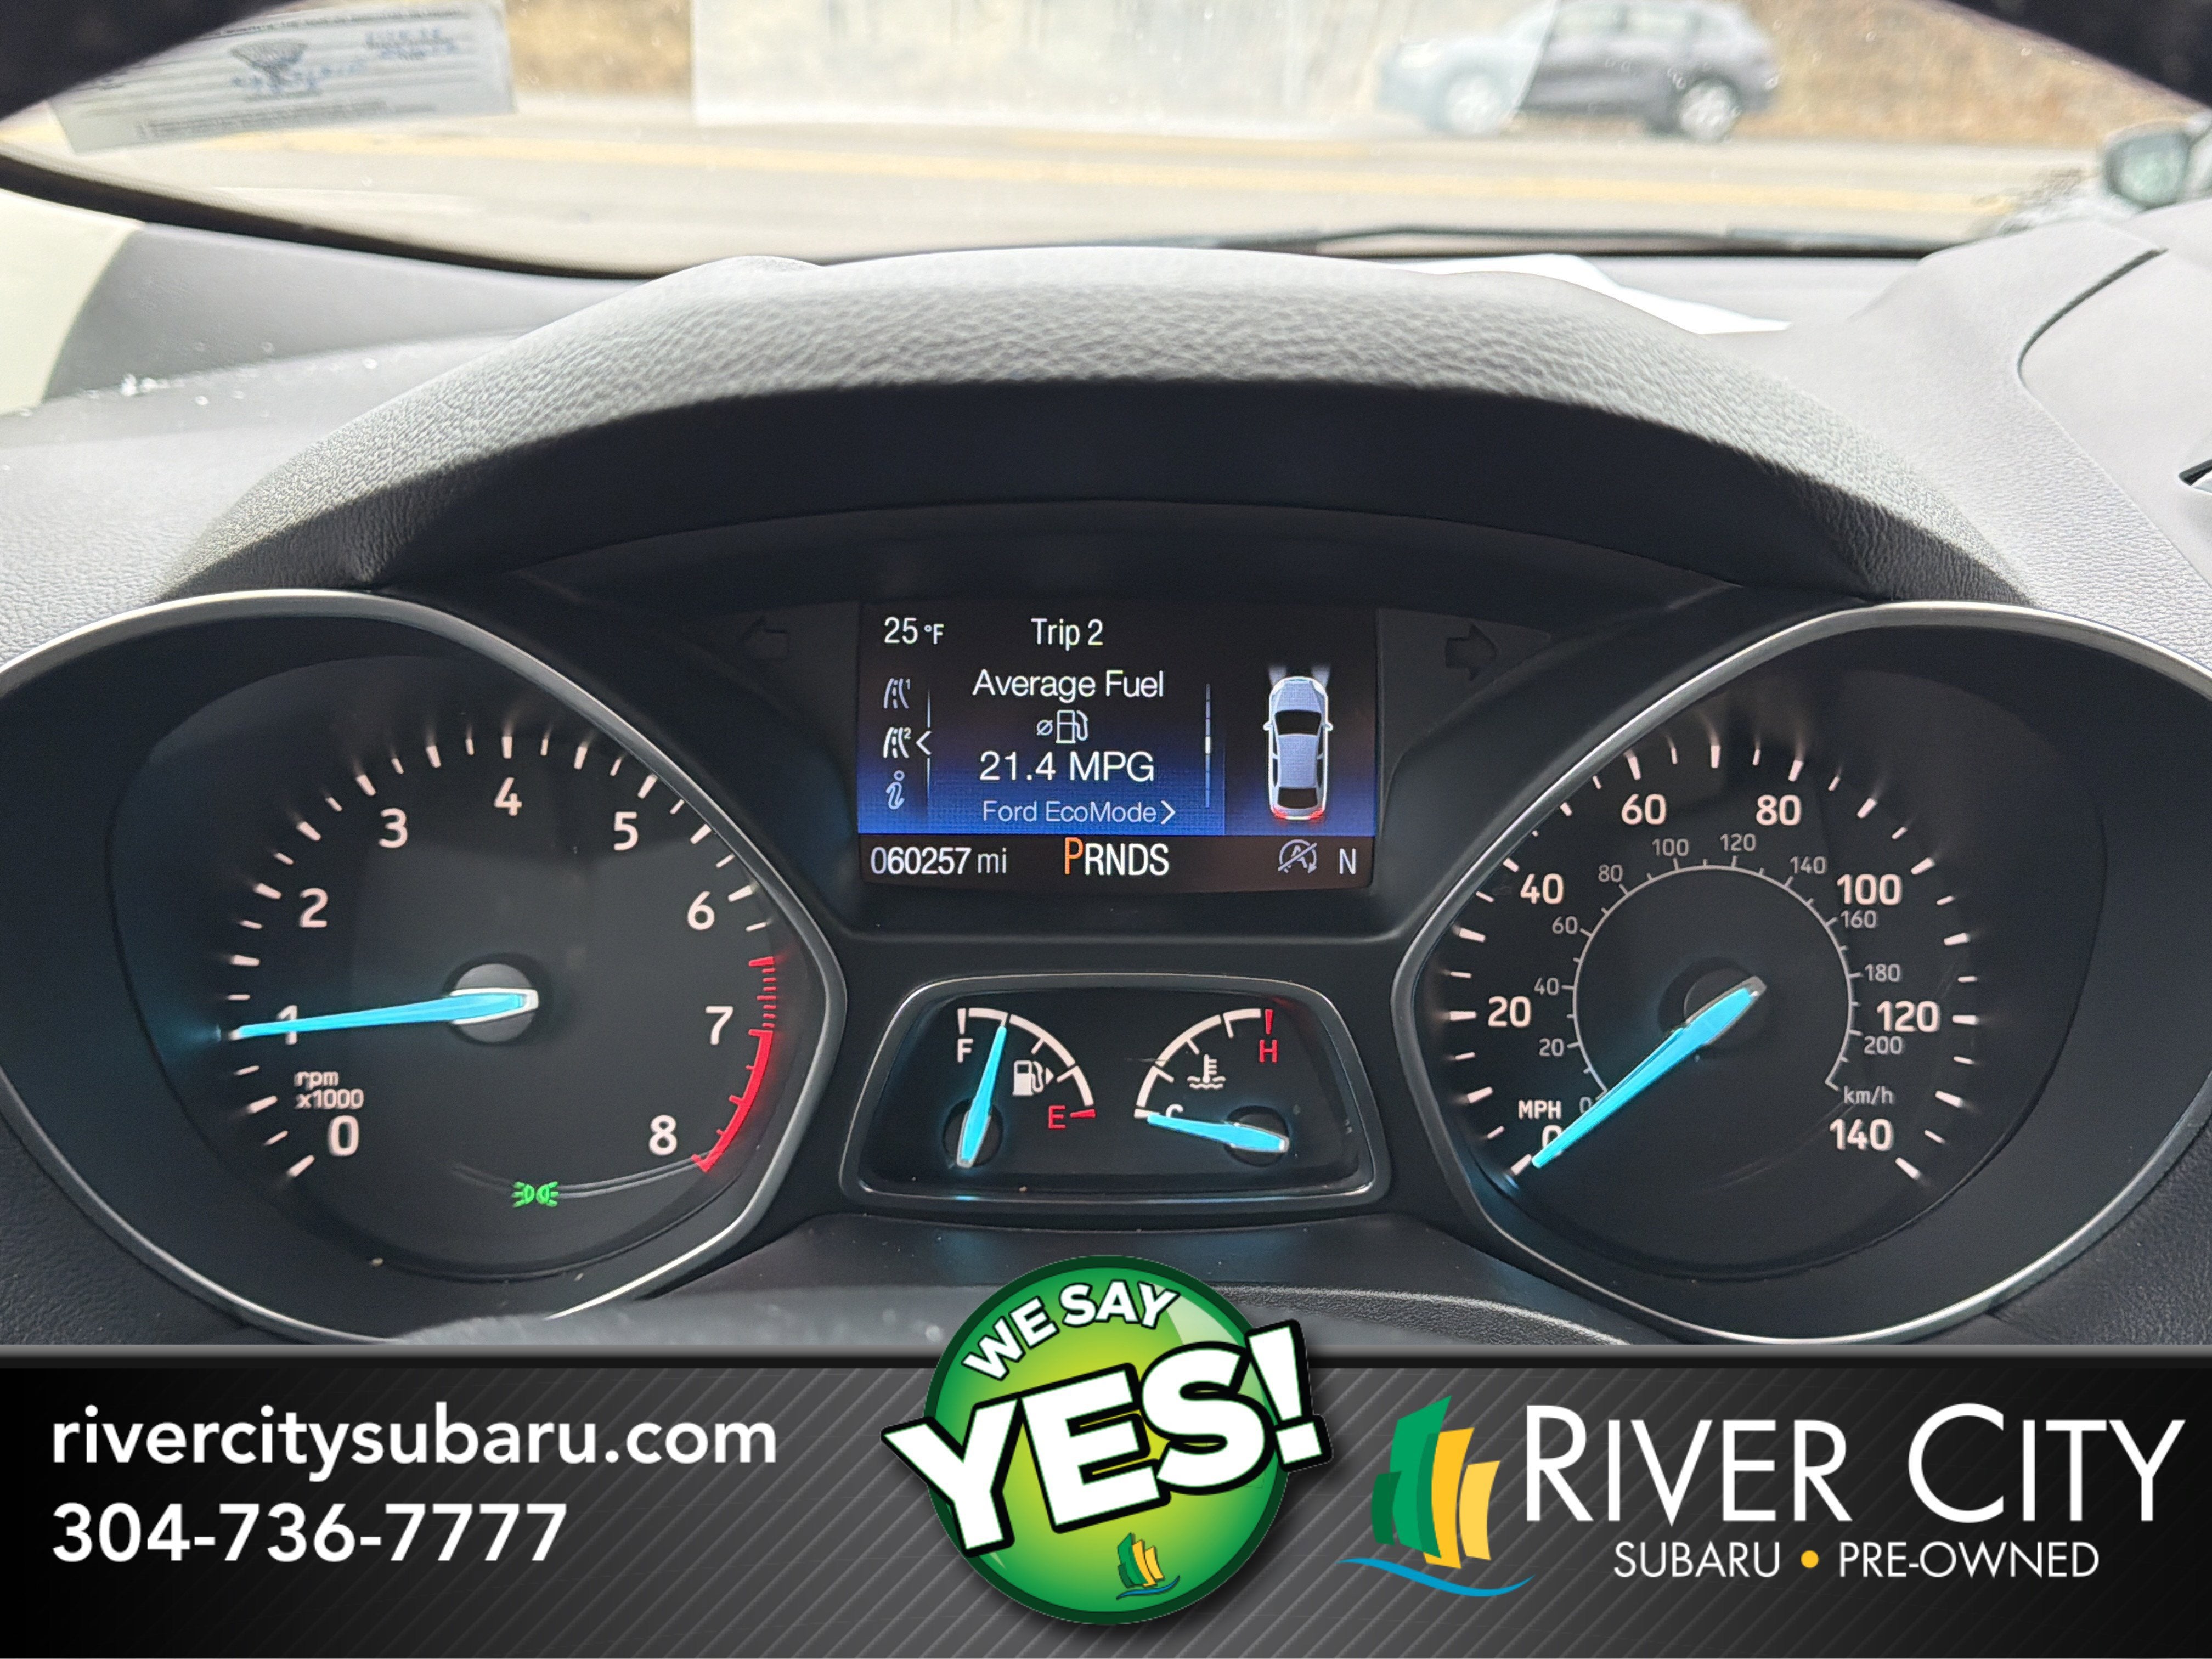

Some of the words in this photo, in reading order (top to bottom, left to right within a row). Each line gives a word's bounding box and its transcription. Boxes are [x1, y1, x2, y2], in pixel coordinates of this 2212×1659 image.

[883, 616, 919, 645] 25
[1030, 618, 1080, 652] Trip
[1088, 618, 1104, 646] 2
[972, 668, 1096, 700] Average
[1105, 670, 1165, 698] Fuel
[979, 751, 1056, 782] 21.4
[1069, 751, 1155, 782] MPG
[494, 777, 522, 816] 4
[983, 800, 1038, 823] Ford
[1045, 800, 1157, 823] EcoMode
[1621, 793, 1668, 826] 60
[1756, 794, 1802, 826] 80
[379, 808, 408, 849] 3
[613, 811, 639, 851] 5
[1720, 832, 1757, 852] 120
[870, 846, 972, 876] 060257
[977, 847, 1007, 874] mi
[1064, 837, 1170, 876] PRNDS
[1339, 847, 1357, 875] N
[1652, 838, 1690, 857] 100
[1598, 864, 1624, 883] 80
[1790, 855, 1827, 875] 140
[1520, 873, 1565, 905] 40
[1837, 873, 1903, 906] 100
[300, 888, 328, 928] 2
[687, 891, 715, 931] 6
[1840, 909, 1877, 929] 160
[1551, 915, 1579, 935] 60
[1533, 977, 1560, 996] 40
[1864, 963, 1901, 983] 180
[276, 1005, 298, 1045] 1
[705, 1005, 733, 1046] 7
[1487, 995, 1532, 1028] 20
[1876, 1000, 1940, 1033] 120
[957, 1037, 974, 1063] F
[1259, 1039, 1278, 1063] H
[1538, 1037, 1565, 1057] 20
[1864, 1035, 1904, 1056] 200
[294, 1071, 340, 1090] rpm
[1843, 1085, 1894, 1105] km/h
[295, 1088, 365, 1110] x1000
[1518, 1099, 1562, 1120] MPH
[1047, 1104, 1066, 1130] E
[328, 1115, 360, 1156] 0
[648, 1114, 678, 1156] 8
[1829, 1119, 1894, 1152] 140
